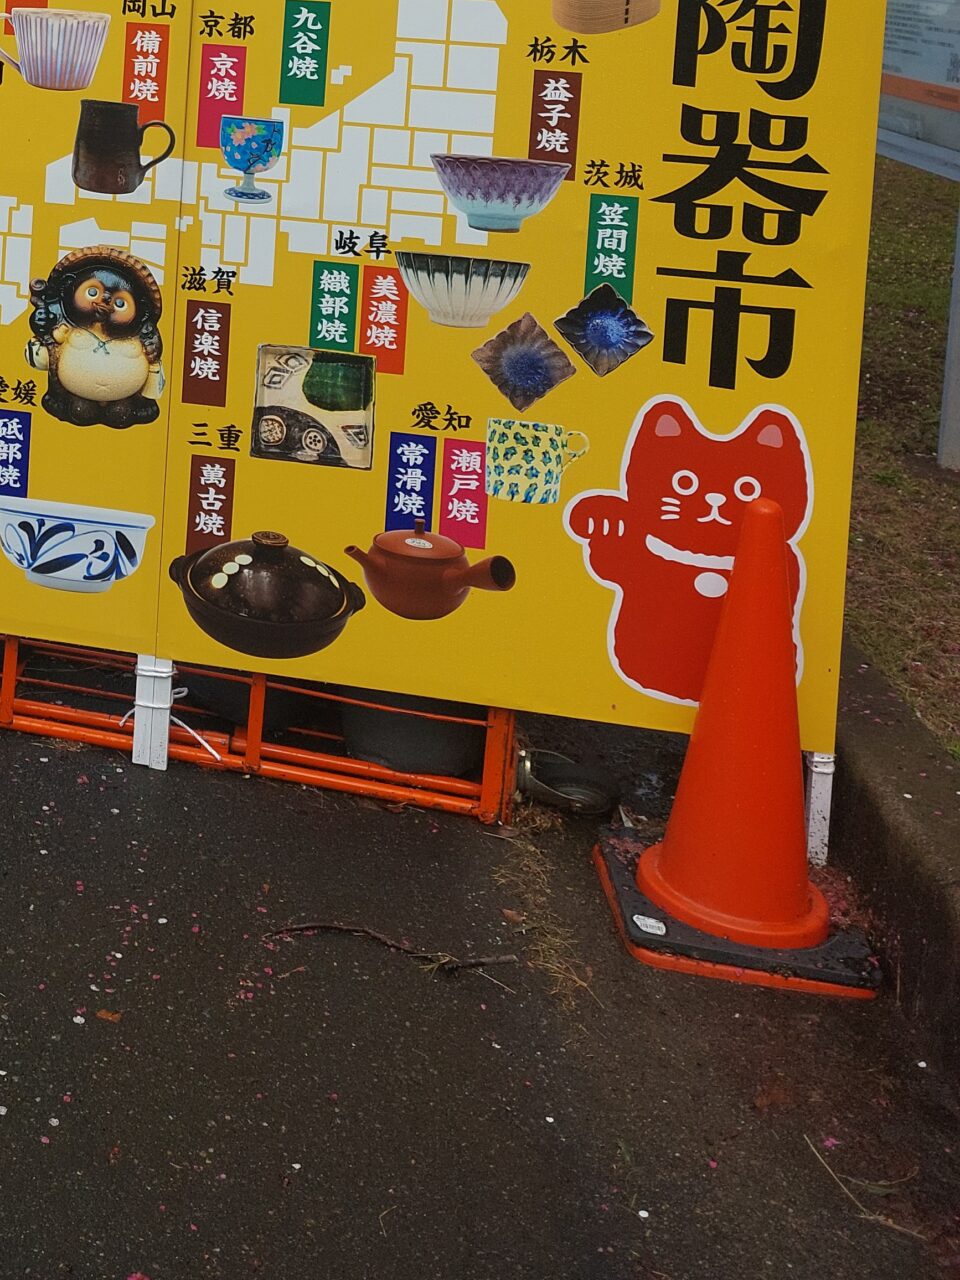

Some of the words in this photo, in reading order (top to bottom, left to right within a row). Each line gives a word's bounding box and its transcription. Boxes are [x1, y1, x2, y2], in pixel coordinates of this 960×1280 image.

[198, 9, 256, 41] 京都
[287, 6, 323, 80] 九谷焼
[526, 36, 590, 67] 栃木
[130, 30, 162, 102] 備前焼
[207, 52, 239, 102] 京焼
[535, 77, 574, 153] 益子焼
[583, 159, 645, 191] 茨城
[334, 229, 392, 260] 岐阜
[592, 202, 630, 279] 笠間焼
[180, 265, 238, 297] 滋賀
[316, 269, 351, 344] 織部焼
[365, 274, 400, 350] 美濃焼
[189, 307, 223, 381] 信楽焼
[187, 422, 244, 452] 三重
[410, 401, 473, 432] 愛知
[393, 441, 430, 517] 常滑焼
[447, 448, 482, 524] 瀬戸焼
